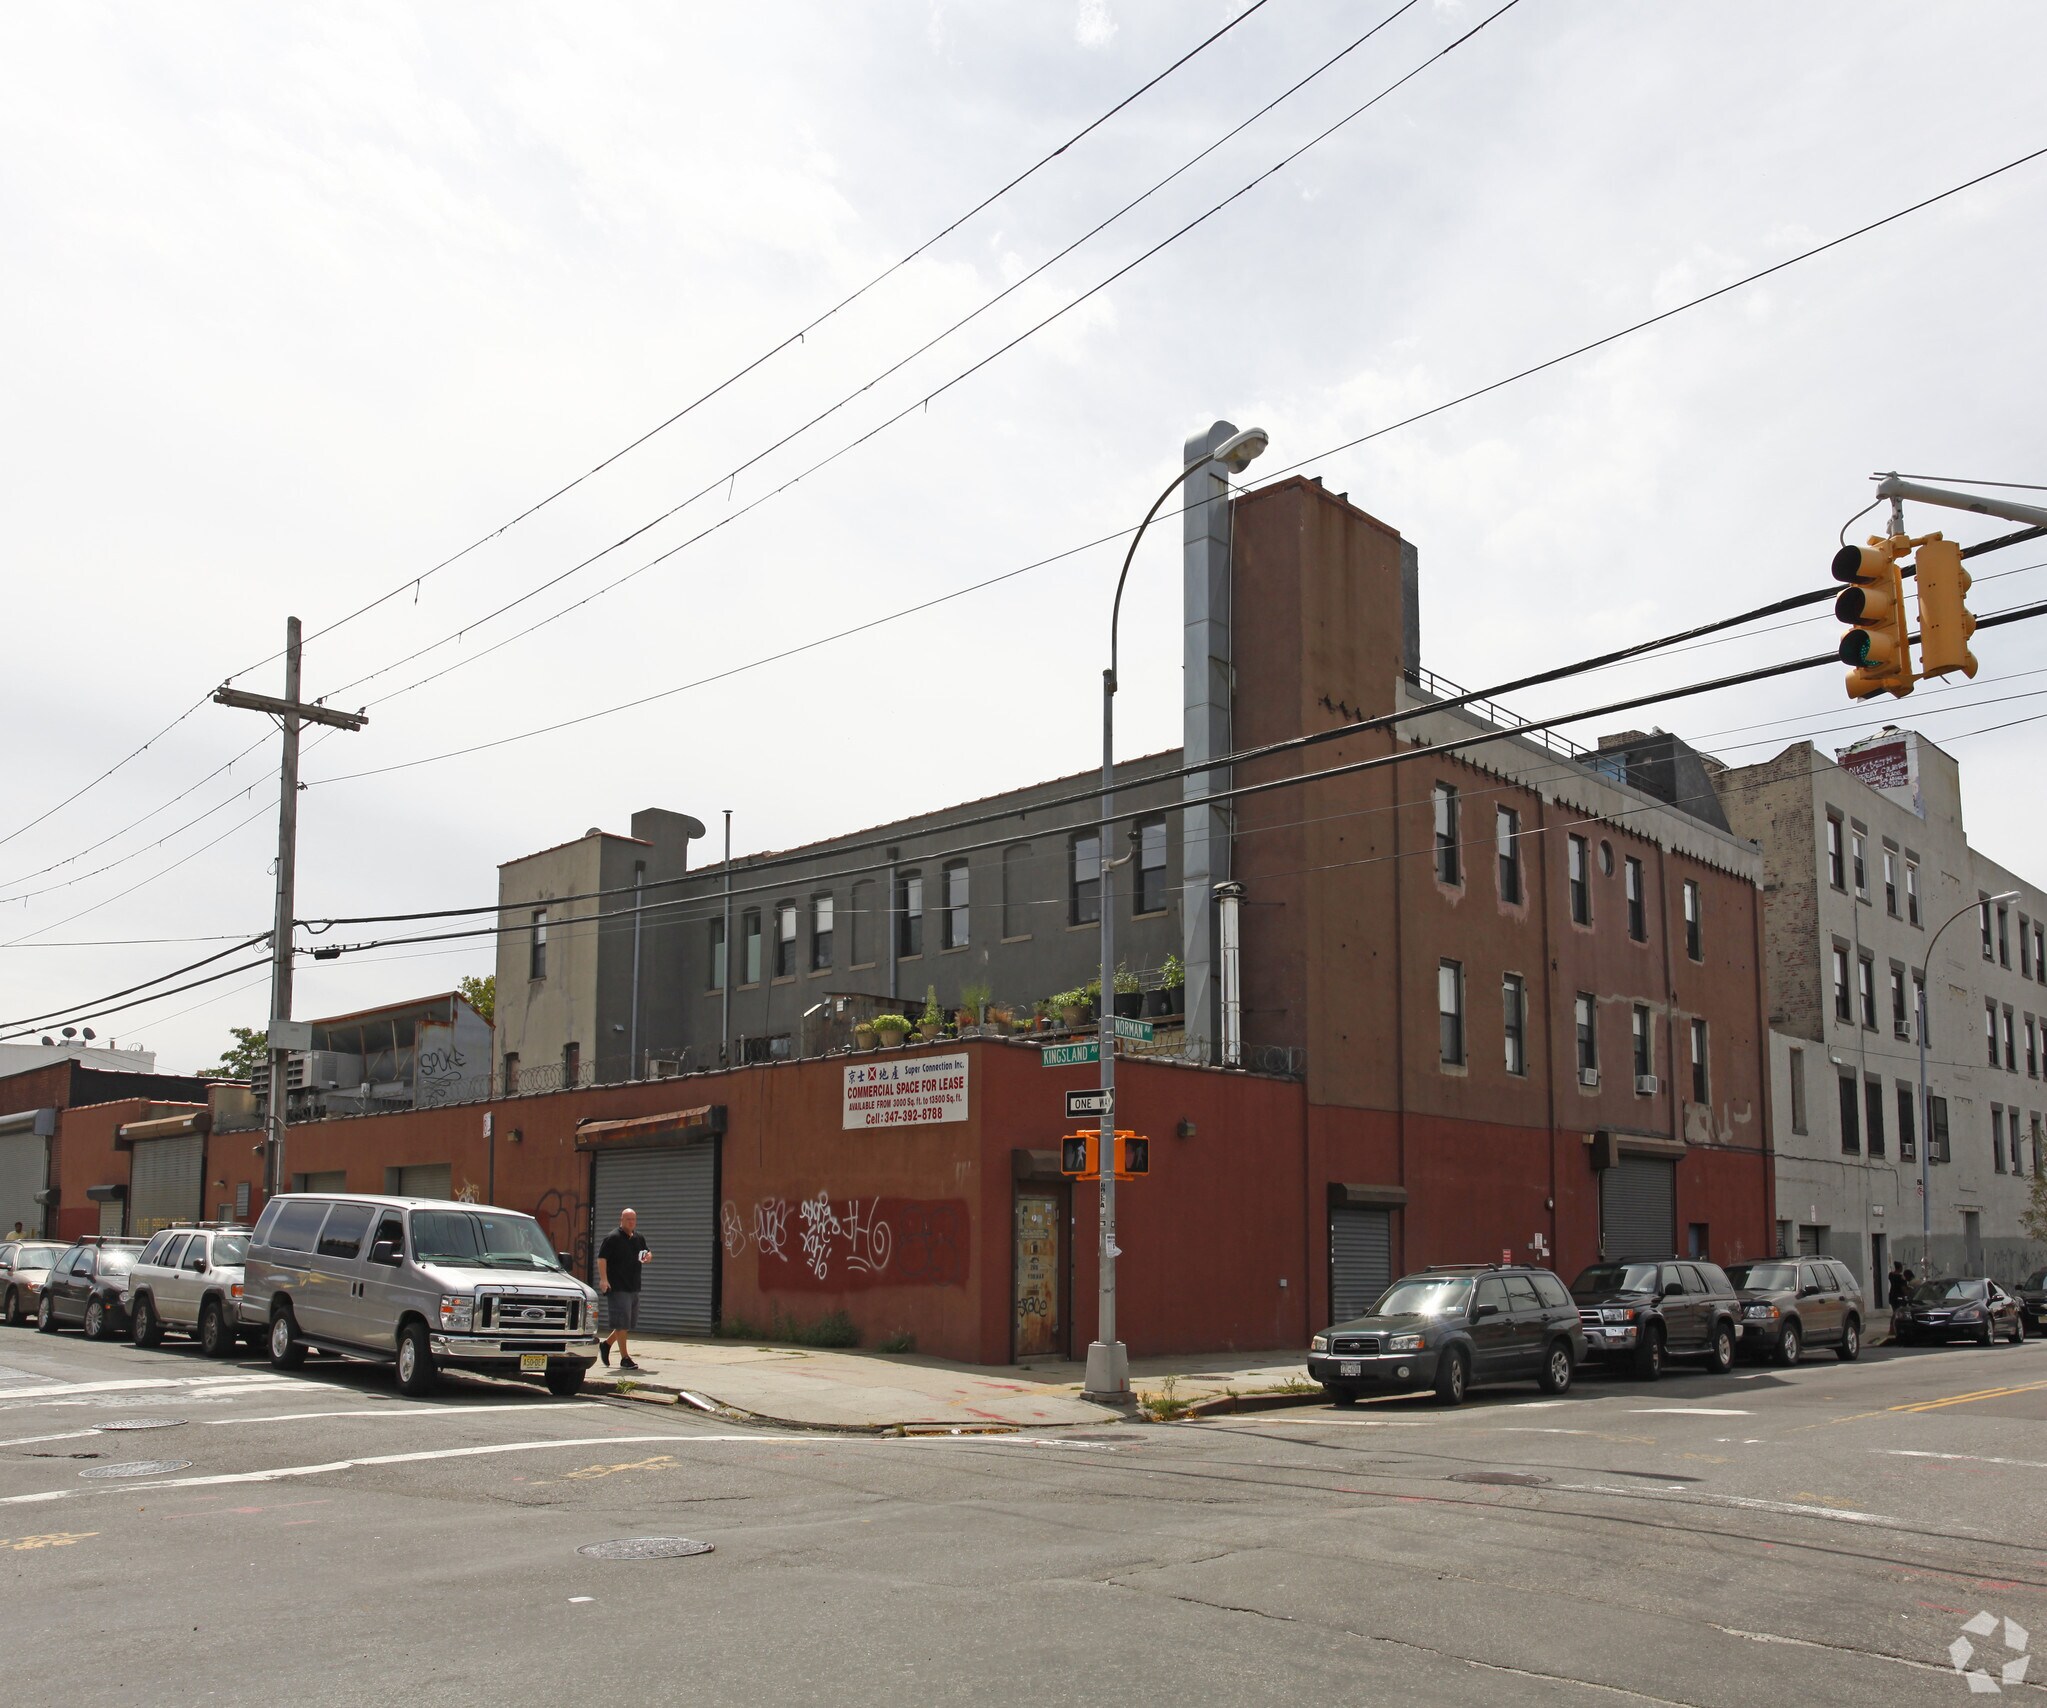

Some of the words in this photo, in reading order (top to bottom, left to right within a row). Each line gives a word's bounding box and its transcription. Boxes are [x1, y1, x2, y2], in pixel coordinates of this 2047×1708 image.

[1115, 1019, 1143, 1038] NORMAN
[1144, 1025, 1151, 1033] AV
[421, 1048, 468, 1076] SPOKE
[1043, 1046, 1088, 1065] KINGSLAND
[1090, 1044, 1099, 1053] AV
[905, 1065, 920, 1076] Super
[922, 1061, 953, 1073] Connection
[954, 1060, 965, 1070] Inc.
[847, 1083, 894, 1099] COMMERCIAL
[896, 1080, 920, 1095] SPACE
[921, 1078, 937, 1092] FOR
[938, 1076, 964, 1091] LEASE
[849, 1100, 875, 1111] AVAILABLE
[876, 1099, 891, 1109] FROM
[893, 1098, 907, 1108] 3000
[923, 1096, 928, 1105] to
[929, 1094, 945, 1104] 13500
[1074, 1098, 1092, 1110] ONE
[1098, 1096, 1112, 1109] WAY
